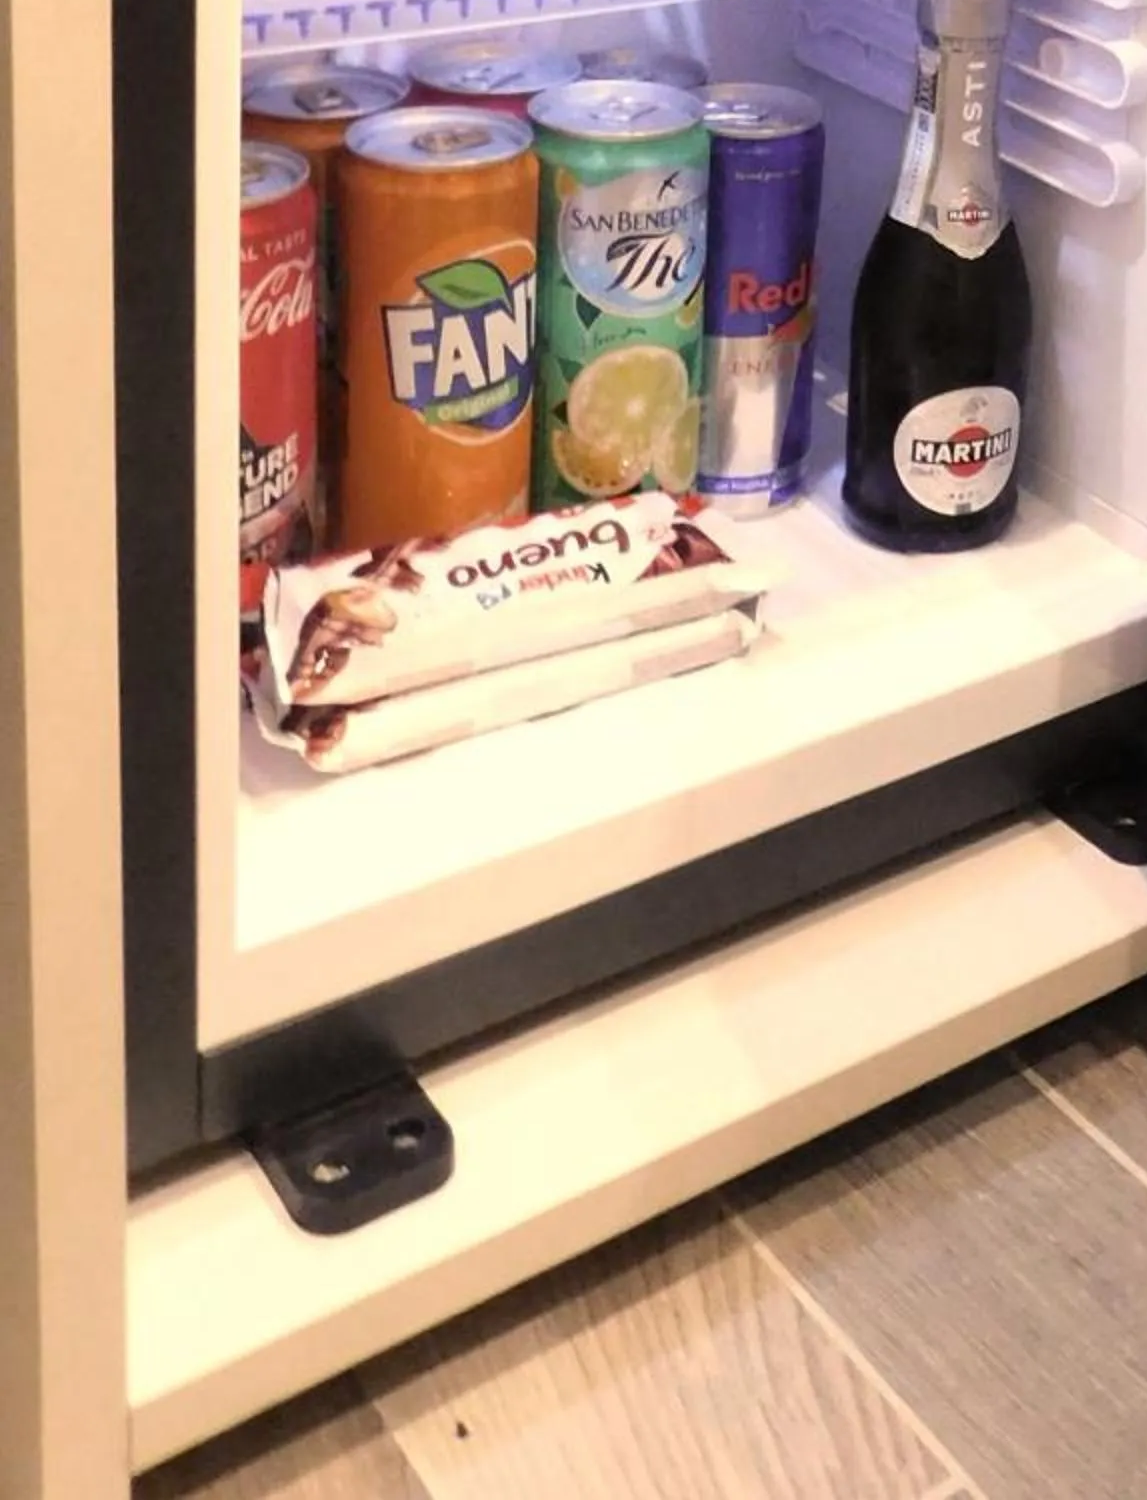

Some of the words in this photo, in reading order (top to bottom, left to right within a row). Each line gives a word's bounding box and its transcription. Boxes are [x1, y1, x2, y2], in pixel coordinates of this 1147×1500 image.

[961, 61, 987, 147] ASTI
[571, 208, 614, 232] SAN
[948, 210, 990, 221] MARTINI
[729, 266, 809, 313] Red
[914, 429, 1012, 463] MARTINI
[446, 519, 631, 588] bueno
